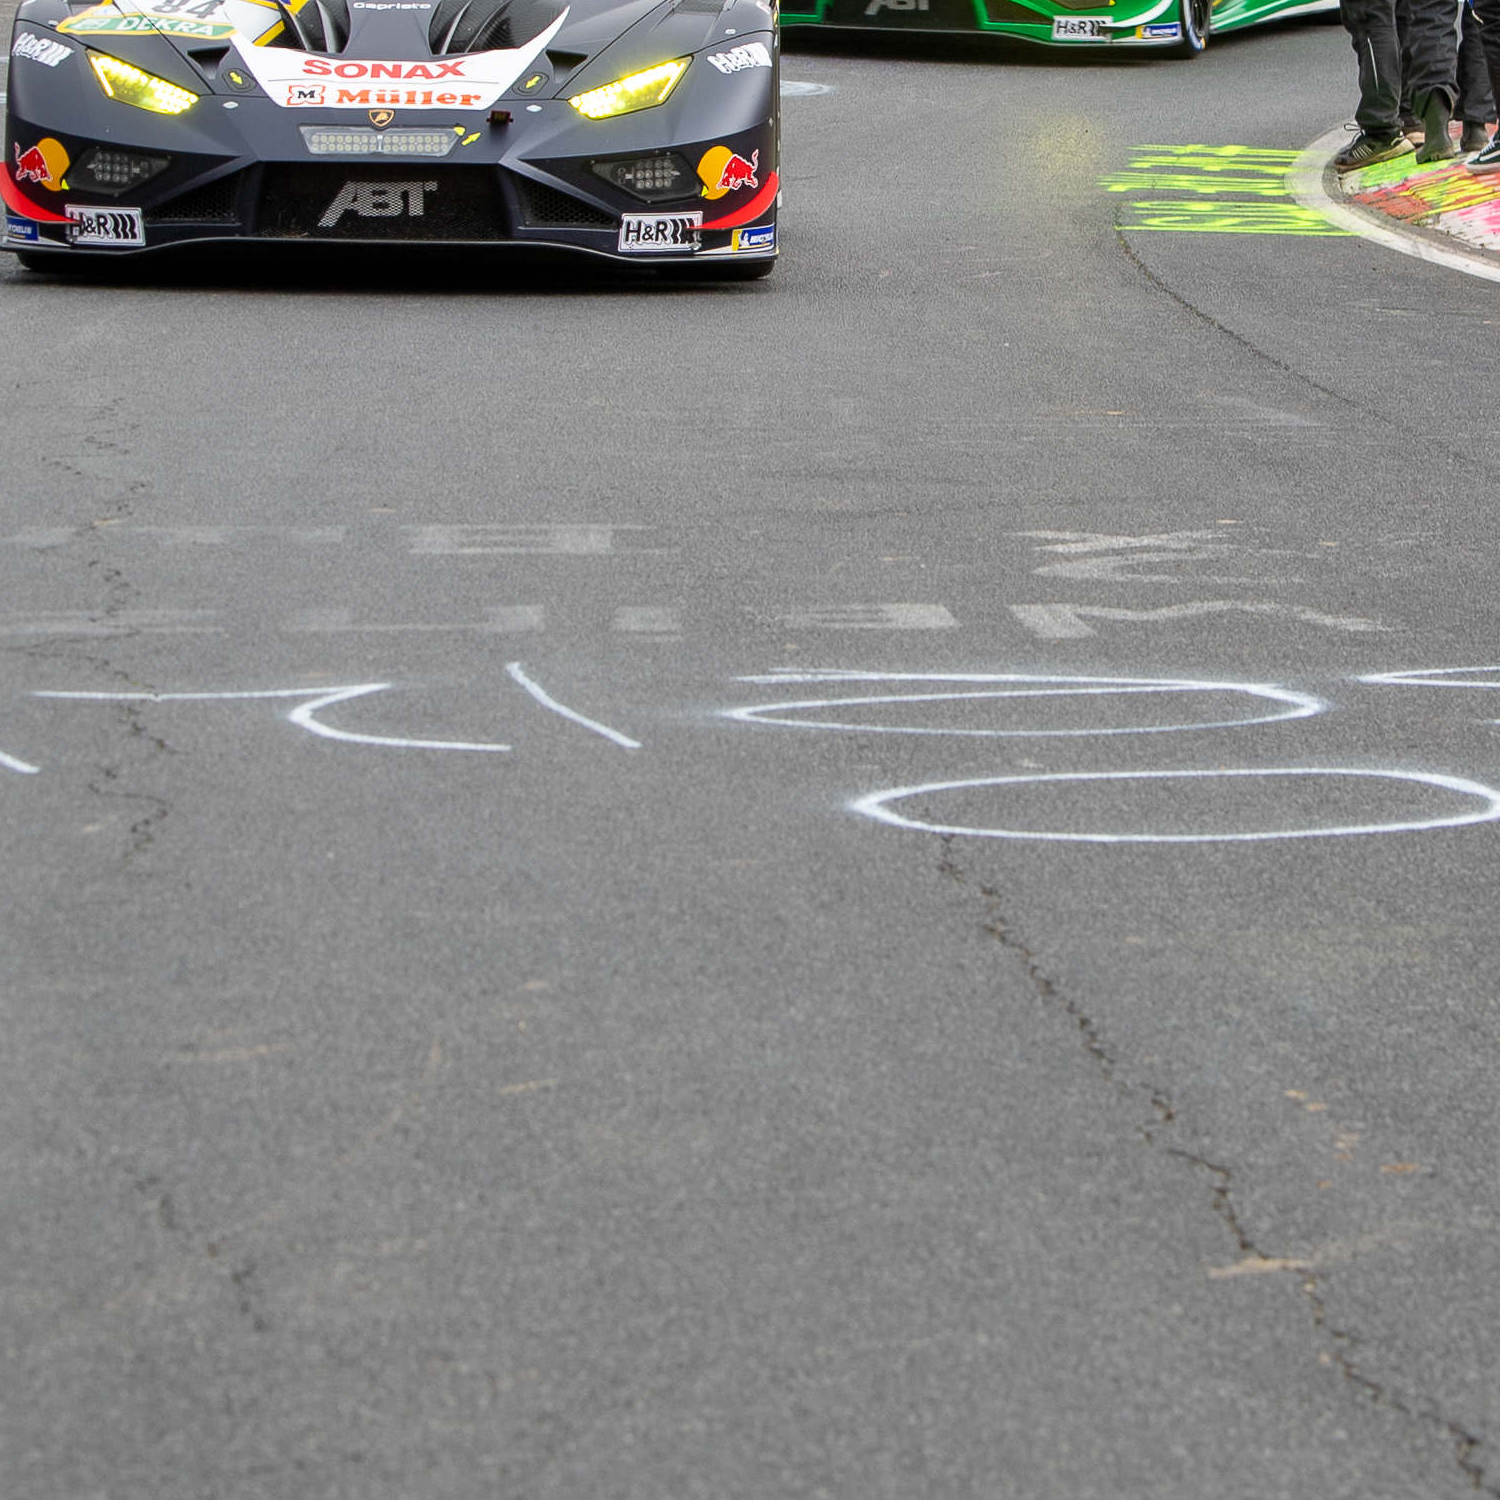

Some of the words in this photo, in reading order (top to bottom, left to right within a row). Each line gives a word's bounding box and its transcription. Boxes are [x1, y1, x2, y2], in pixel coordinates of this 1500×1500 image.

[116, 15, 214, 37] DEKRA
[302, 58, 467, 80] SONAX
[336, 88, 482, 107] Müller
[317, 180, 439, 228] ABT
